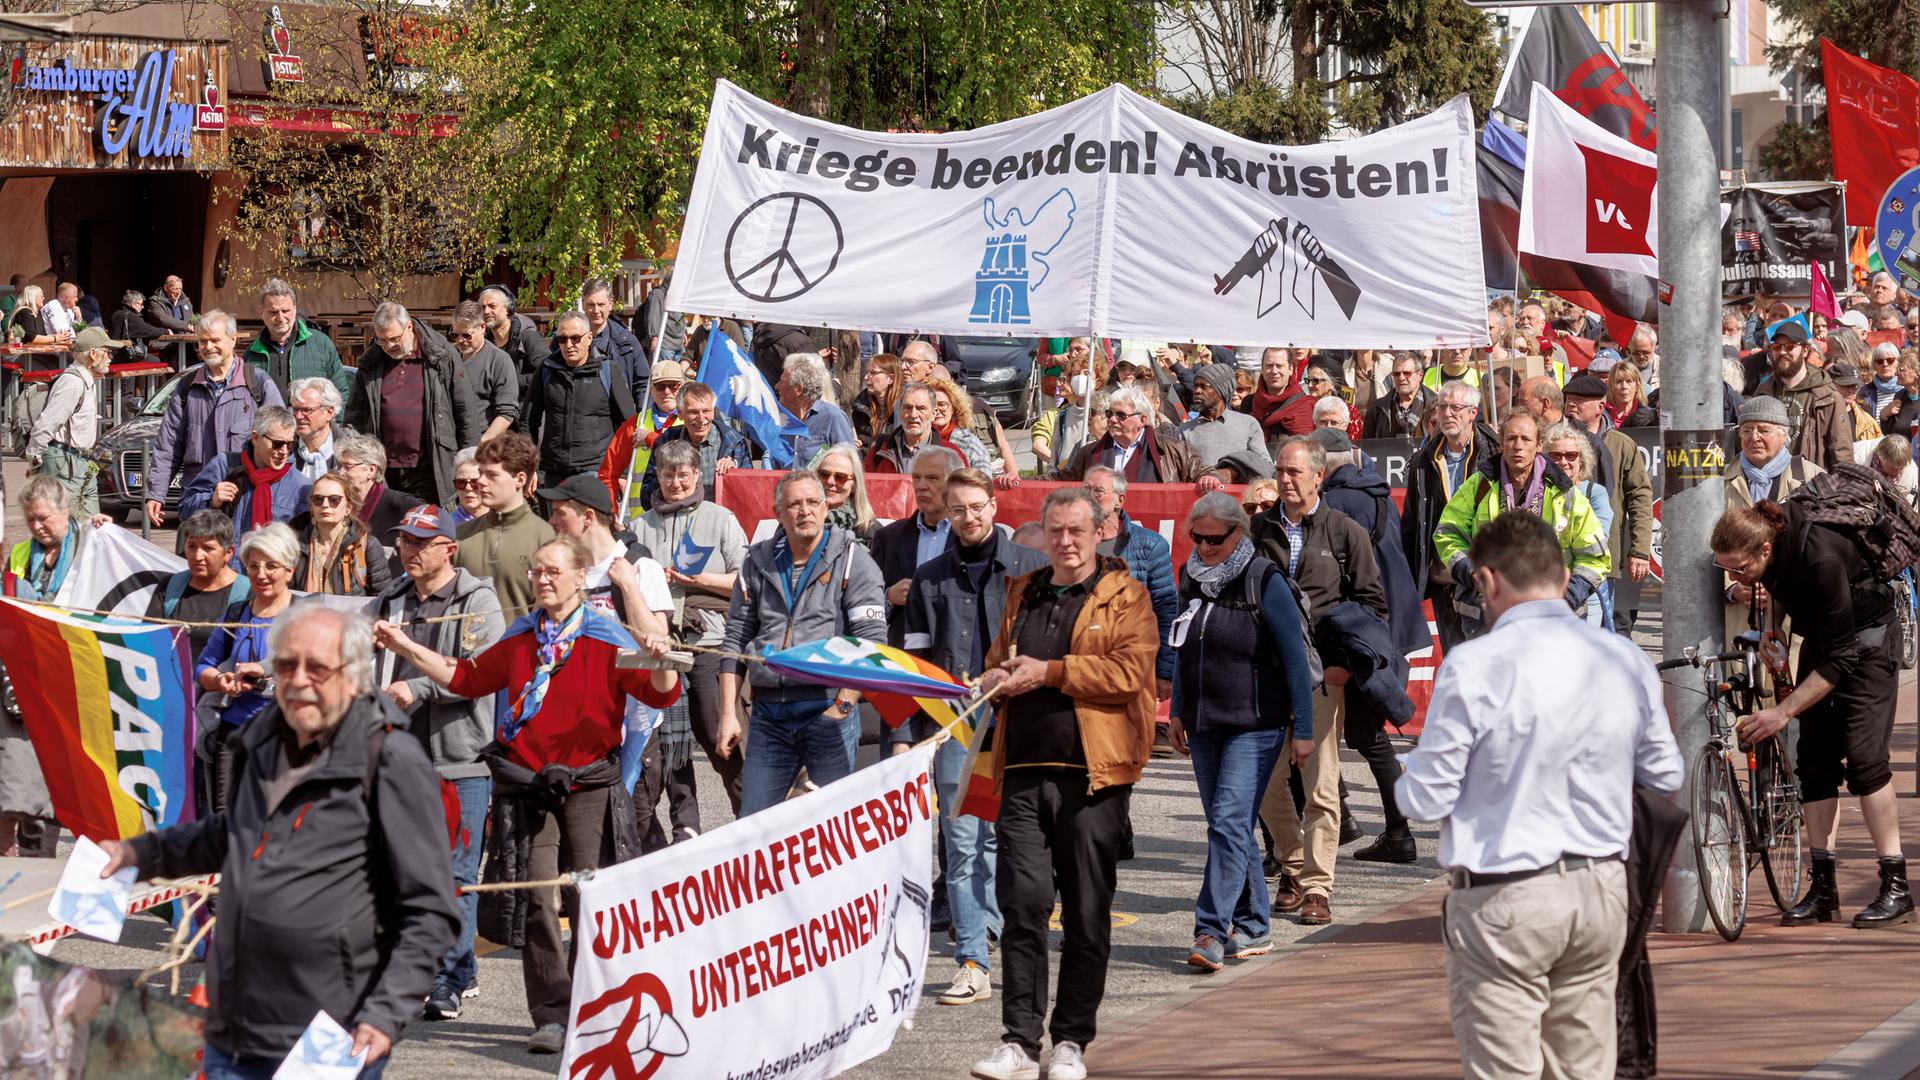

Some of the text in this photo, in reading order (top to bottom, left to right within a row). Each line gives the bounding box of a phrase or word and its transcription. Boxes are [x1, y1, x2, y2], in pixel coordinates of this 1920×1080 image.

[102, 49, 194, 158] Alm
[200, 112, 224, 124] ASTRA
[737, 122, 1449, 199] Kriege beenden! Abrüsten!
[97, 640, 168, 832] PAC
[592, 771, 930, 960] UN-ATOMWAFFENVERBOT
